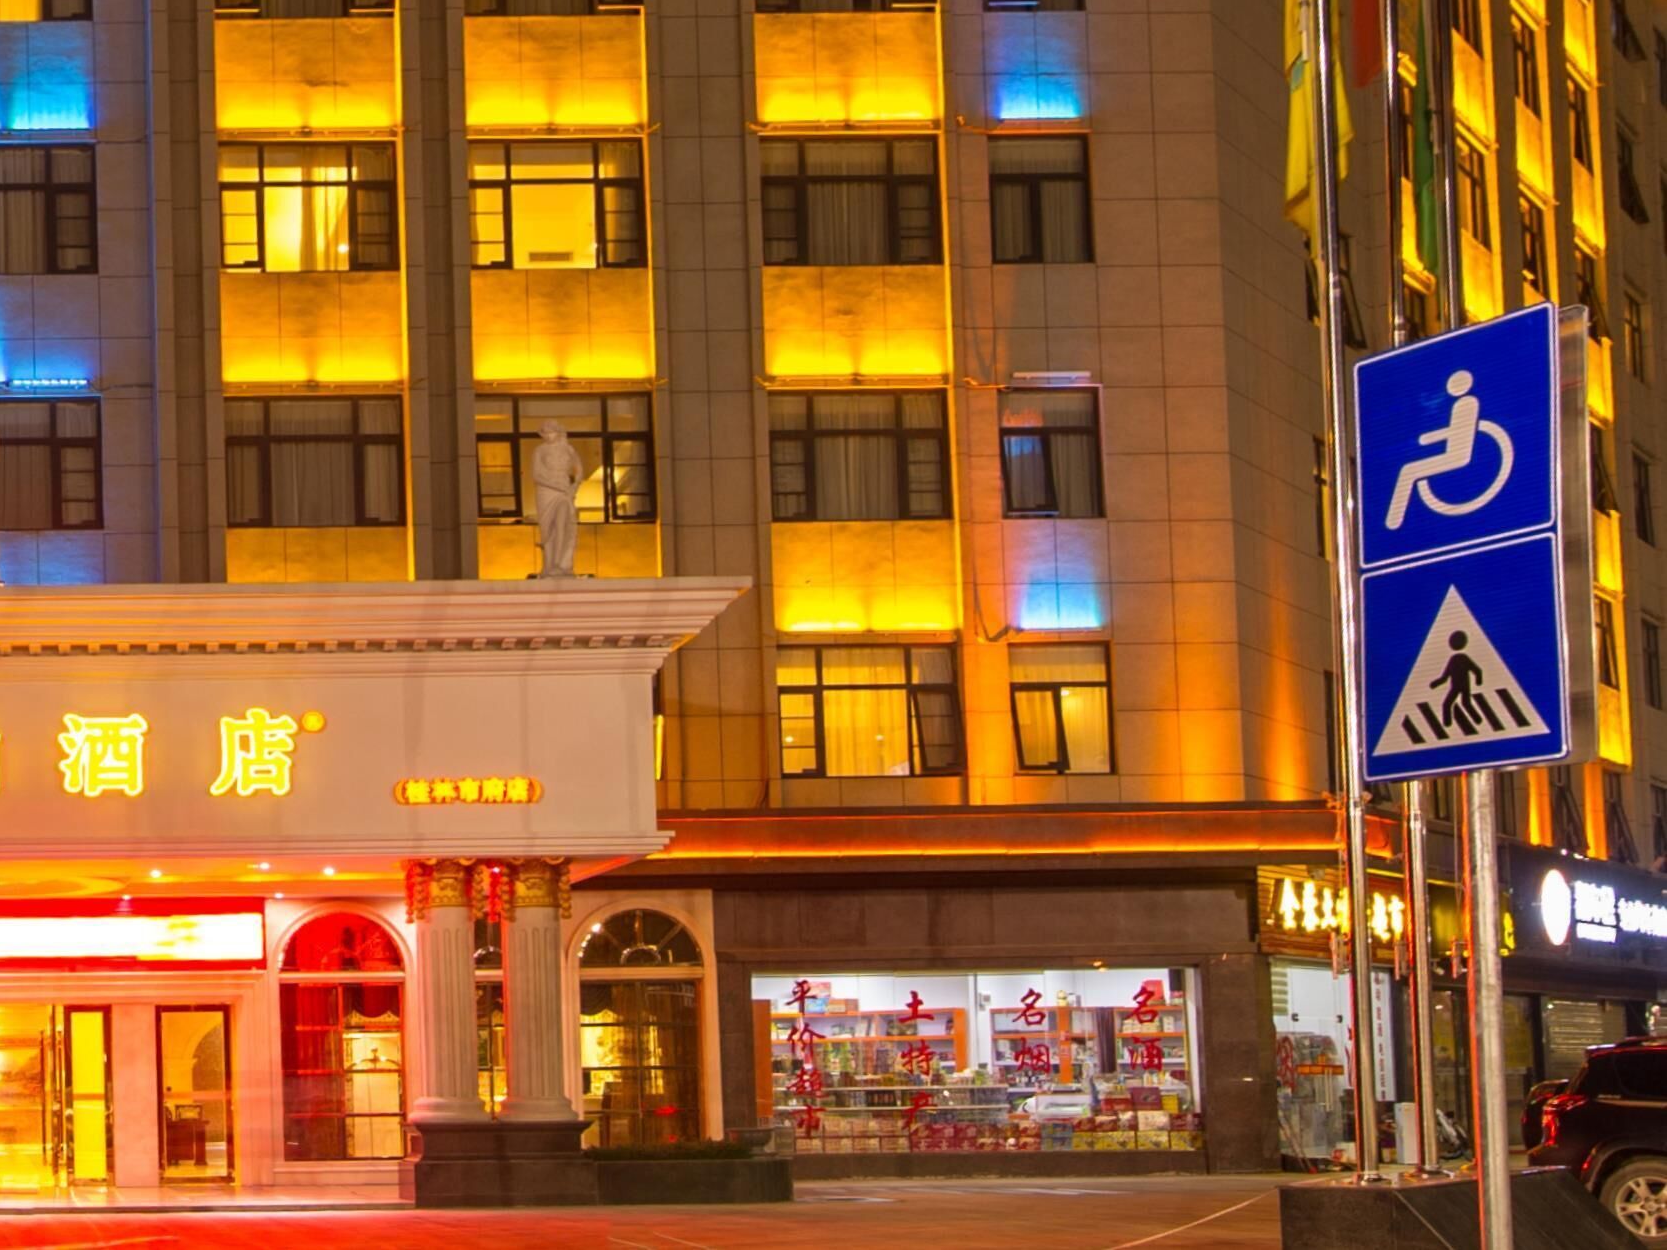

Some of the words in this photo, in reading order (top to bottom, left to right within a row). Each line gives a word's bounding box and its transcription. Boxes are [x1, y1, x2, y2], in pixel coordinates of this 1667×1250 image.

[785, 979, 829, 1139] 平价超市
[898, 990, 939, 1132] 土特产
[1012, 987, 1051, 1074] 名烟
[1125, 985, 1163, 1072] 名酒
